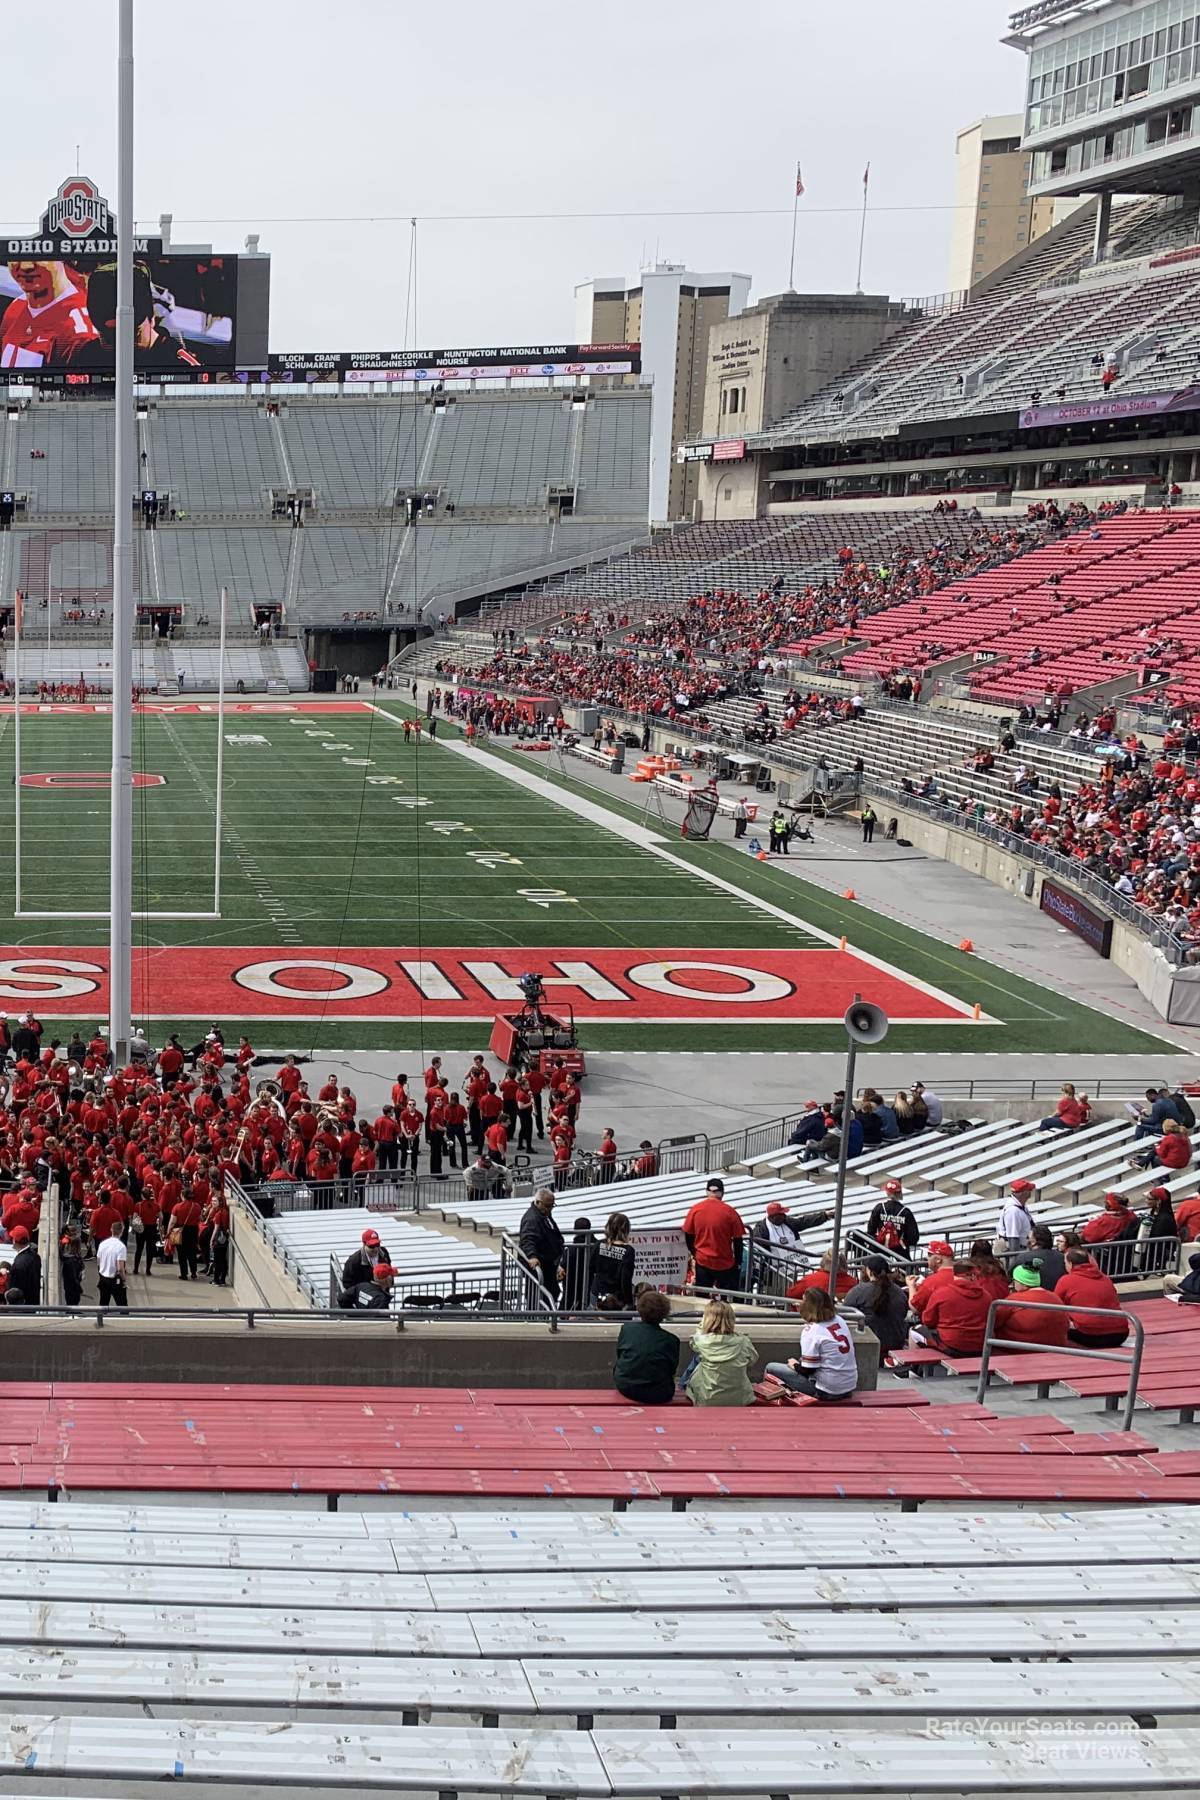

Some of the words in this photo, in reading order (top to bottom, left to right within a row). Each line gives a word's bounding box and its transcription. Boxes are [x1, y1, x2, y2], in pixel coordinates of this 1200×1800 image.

[8, 240, 54, 253] OHIO
[61, 240, 149, 253] STADIM
[390, 352, 434, 360] McCORKLE
[444, 350, 497, 358] HUNTINGTON
[499, 348, 542, 356] NATIONAL
[278, 354, 304, 362] BLOCH
[314, 354, 341, 362] CRANE
[436, 358, 469, 366] NOURSE
[352, 360, 418, 368] O'SHAUGHNESSY
[160, 374, 175, 382] GRAY
[202, 373, 208, 382] 0
[1058, 406, 1091, 419] OCTOBER
[1102, 406, 1110, 414] at
[1111, 403, 1127, 414] Ohio
[1128, 400, 1157, 412] Stadium
[827, 1323, 851, 1354] 5
